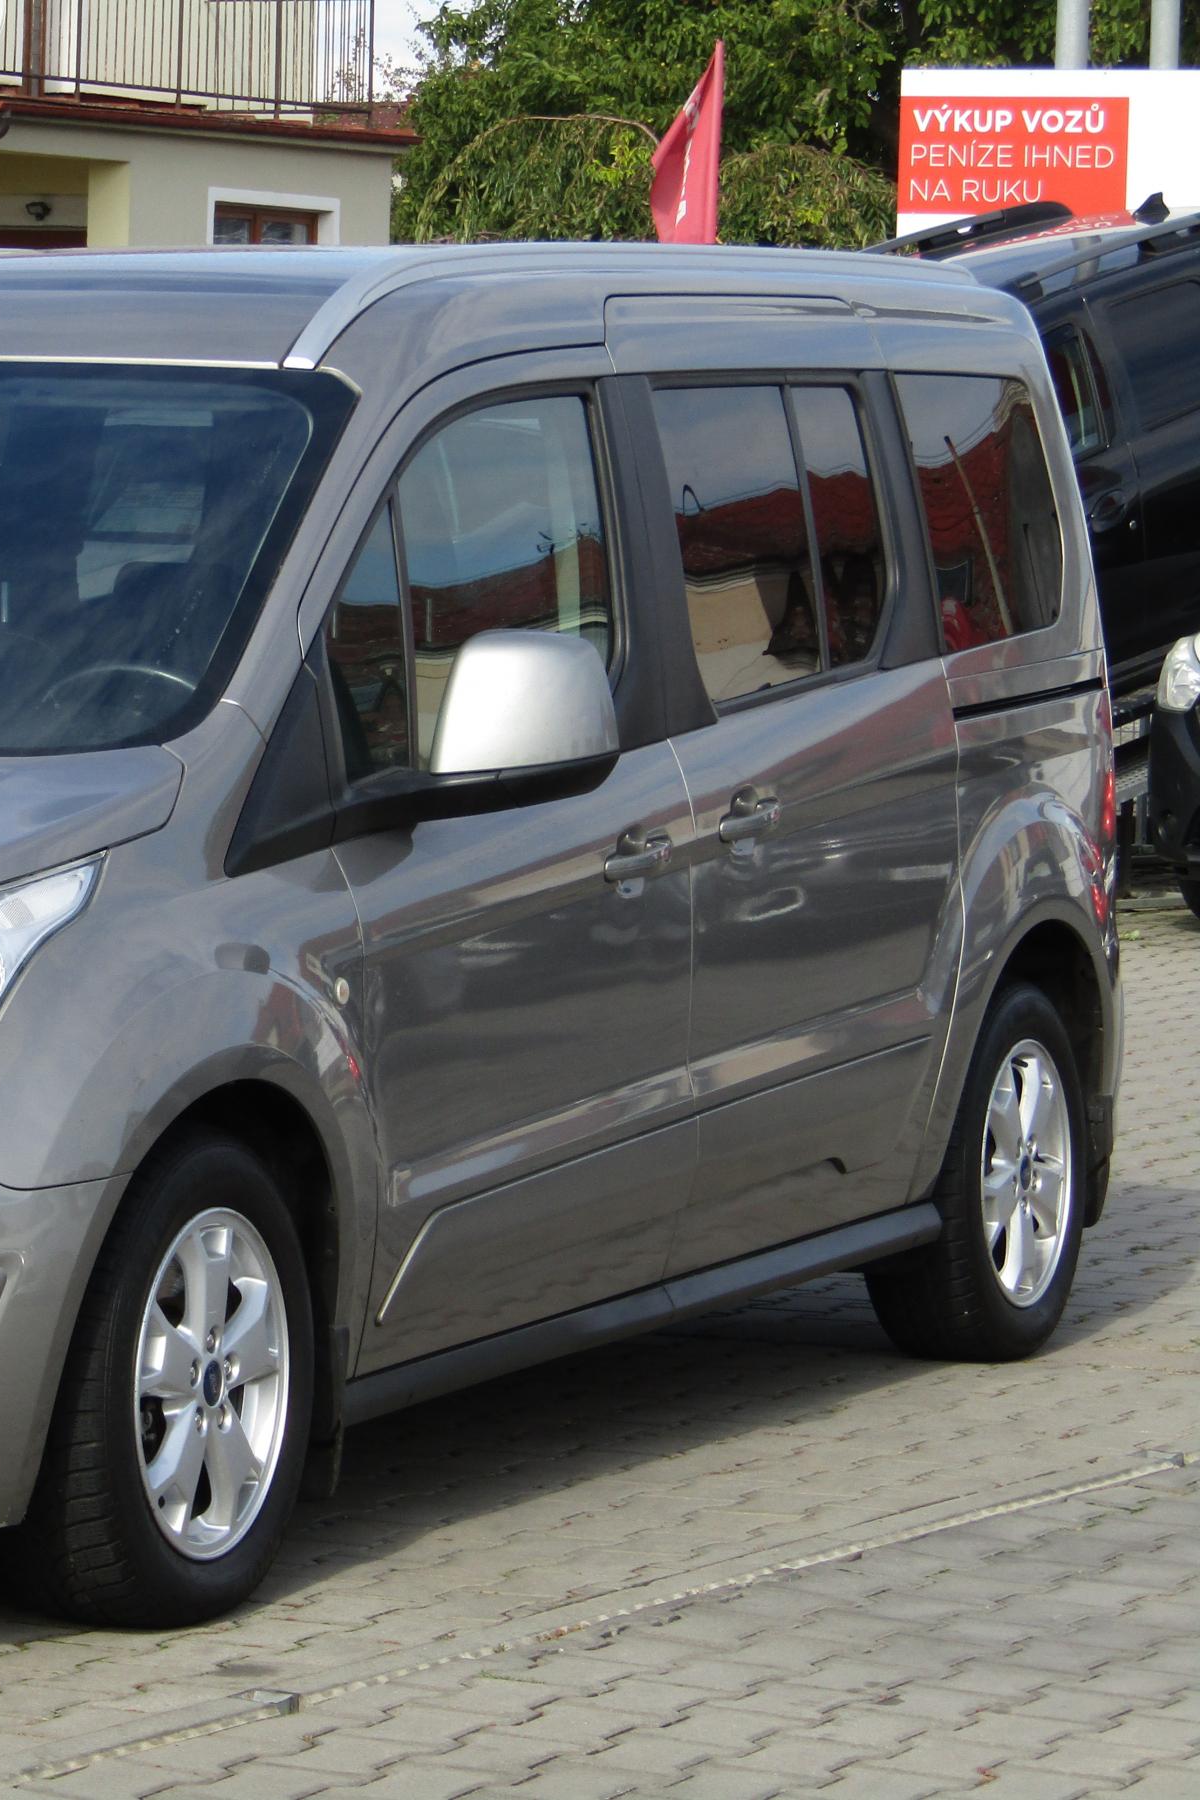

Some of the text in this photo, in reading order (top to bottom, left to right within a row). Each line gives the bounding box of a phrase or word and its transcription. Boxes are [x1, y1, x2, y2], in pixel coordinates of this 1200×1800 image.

[912, 103, 1105, 133] VÝKUP VOZŮ
[910, 140, 1114, 169] PENÍZE IHNED
[909, 179, 1042, 203] NA RUKU
